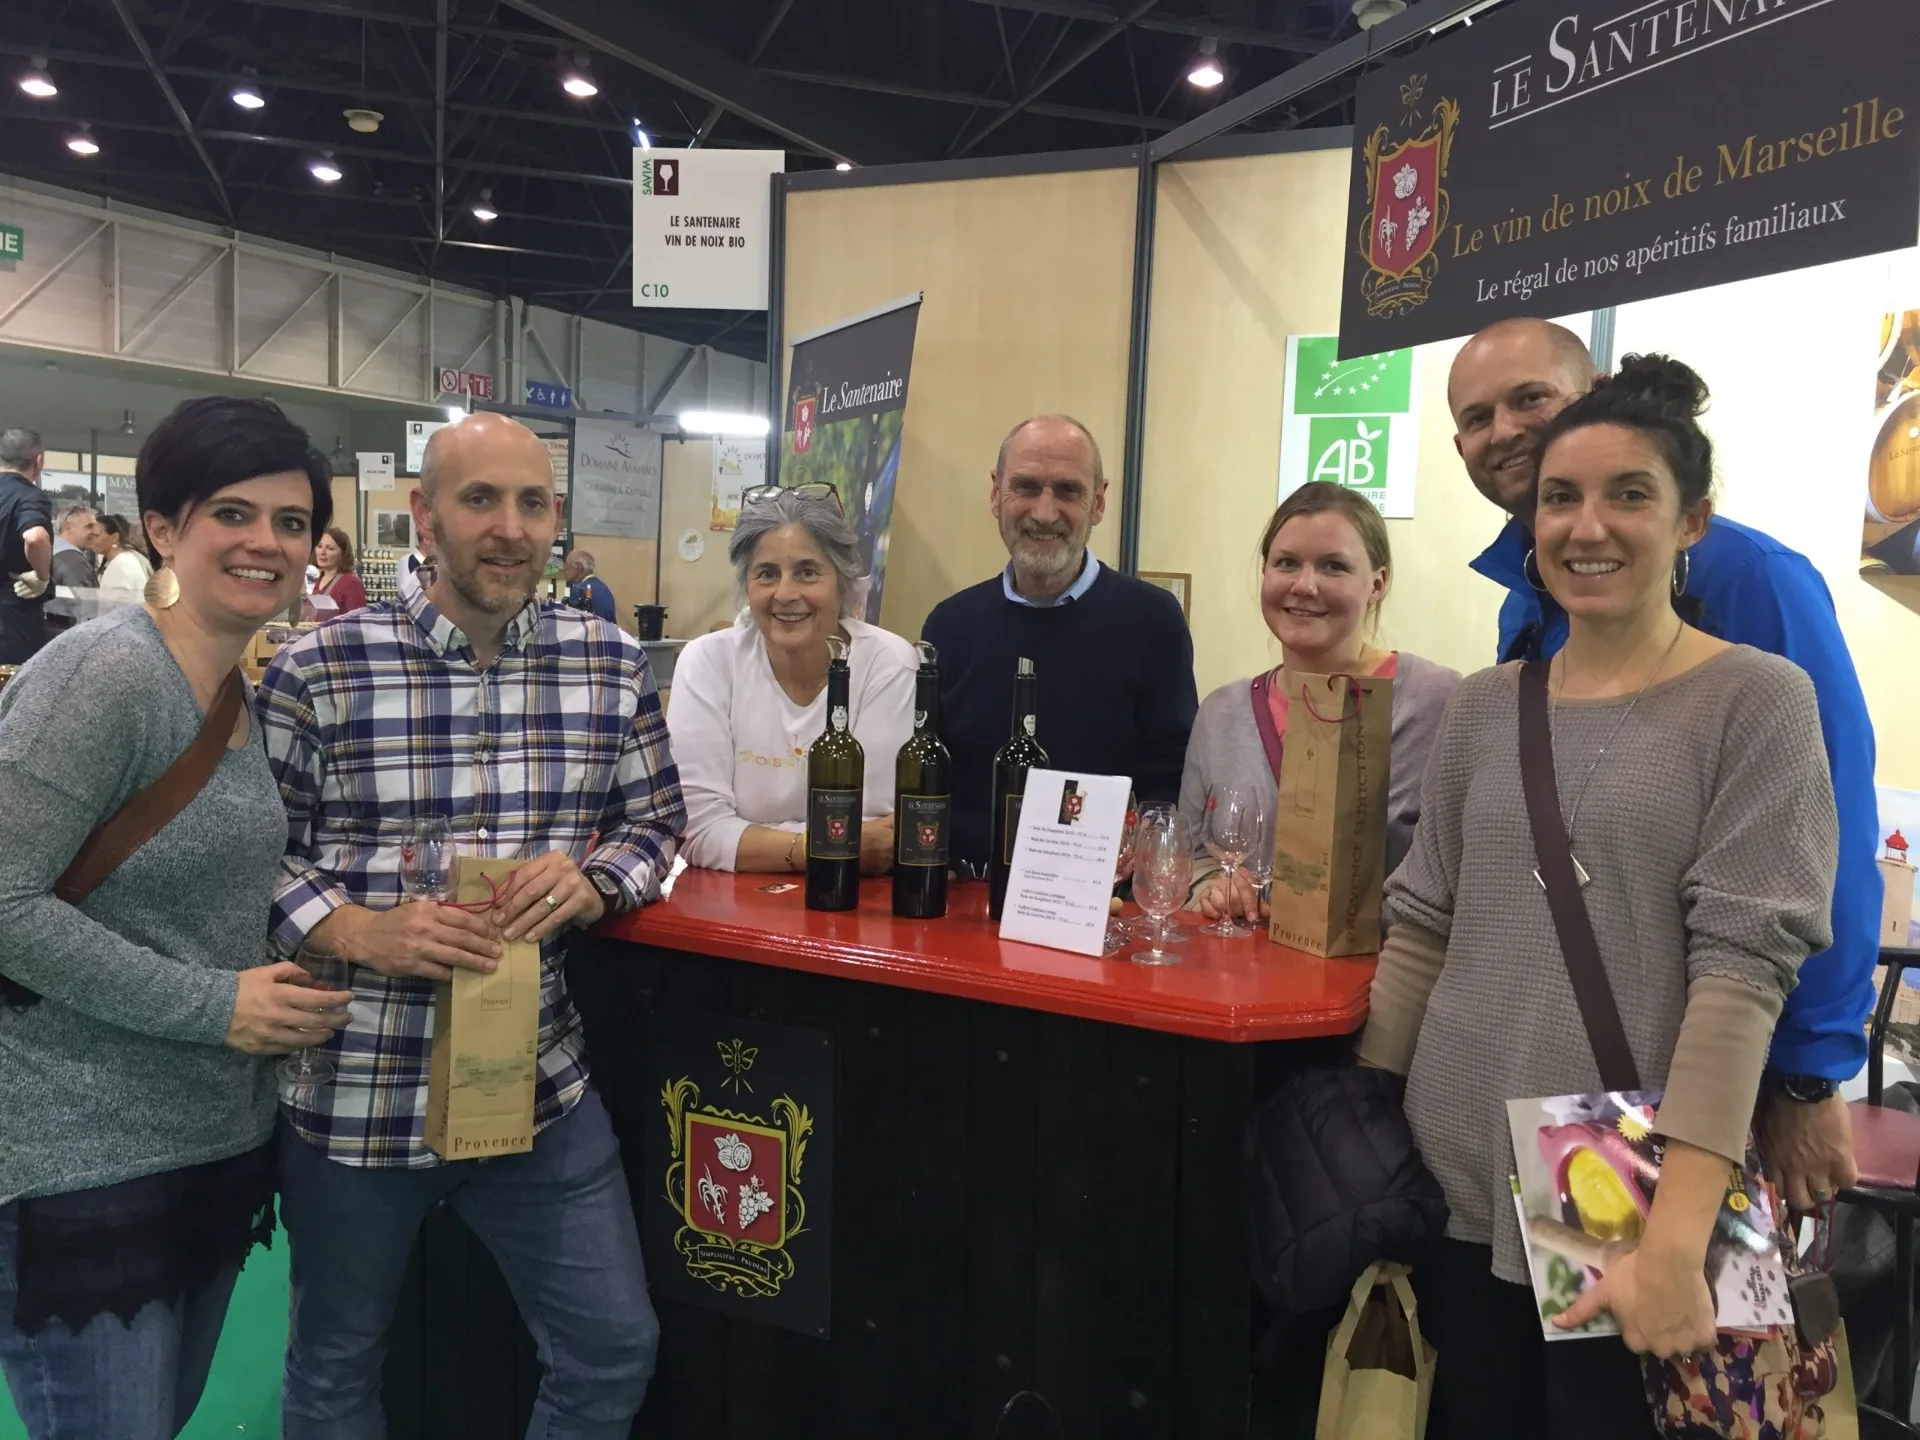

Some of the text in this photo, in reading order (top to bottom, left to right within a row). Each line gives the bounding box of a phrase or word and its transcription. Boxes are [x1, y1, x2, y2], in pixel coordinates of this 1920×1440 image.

[1489, 0, 1786, 119] LE SANTEN
[642, 158, 653, 196] SAVIM
[1451, 97, 1905, 258] Le vin de noix de Marseille
[664, 234, 746, 249] VIN DE NOIX BIO
[670, 215, 741, 229] LE SANTENAIRE
[1475, 198, 1847, 304] Le régal de nos apéritifs familiaux
[821, 370, 903, 414] Le Santenaire
[1312, 438, 1375, 487] AB
[453, 1135, 527, 1153] Provence
